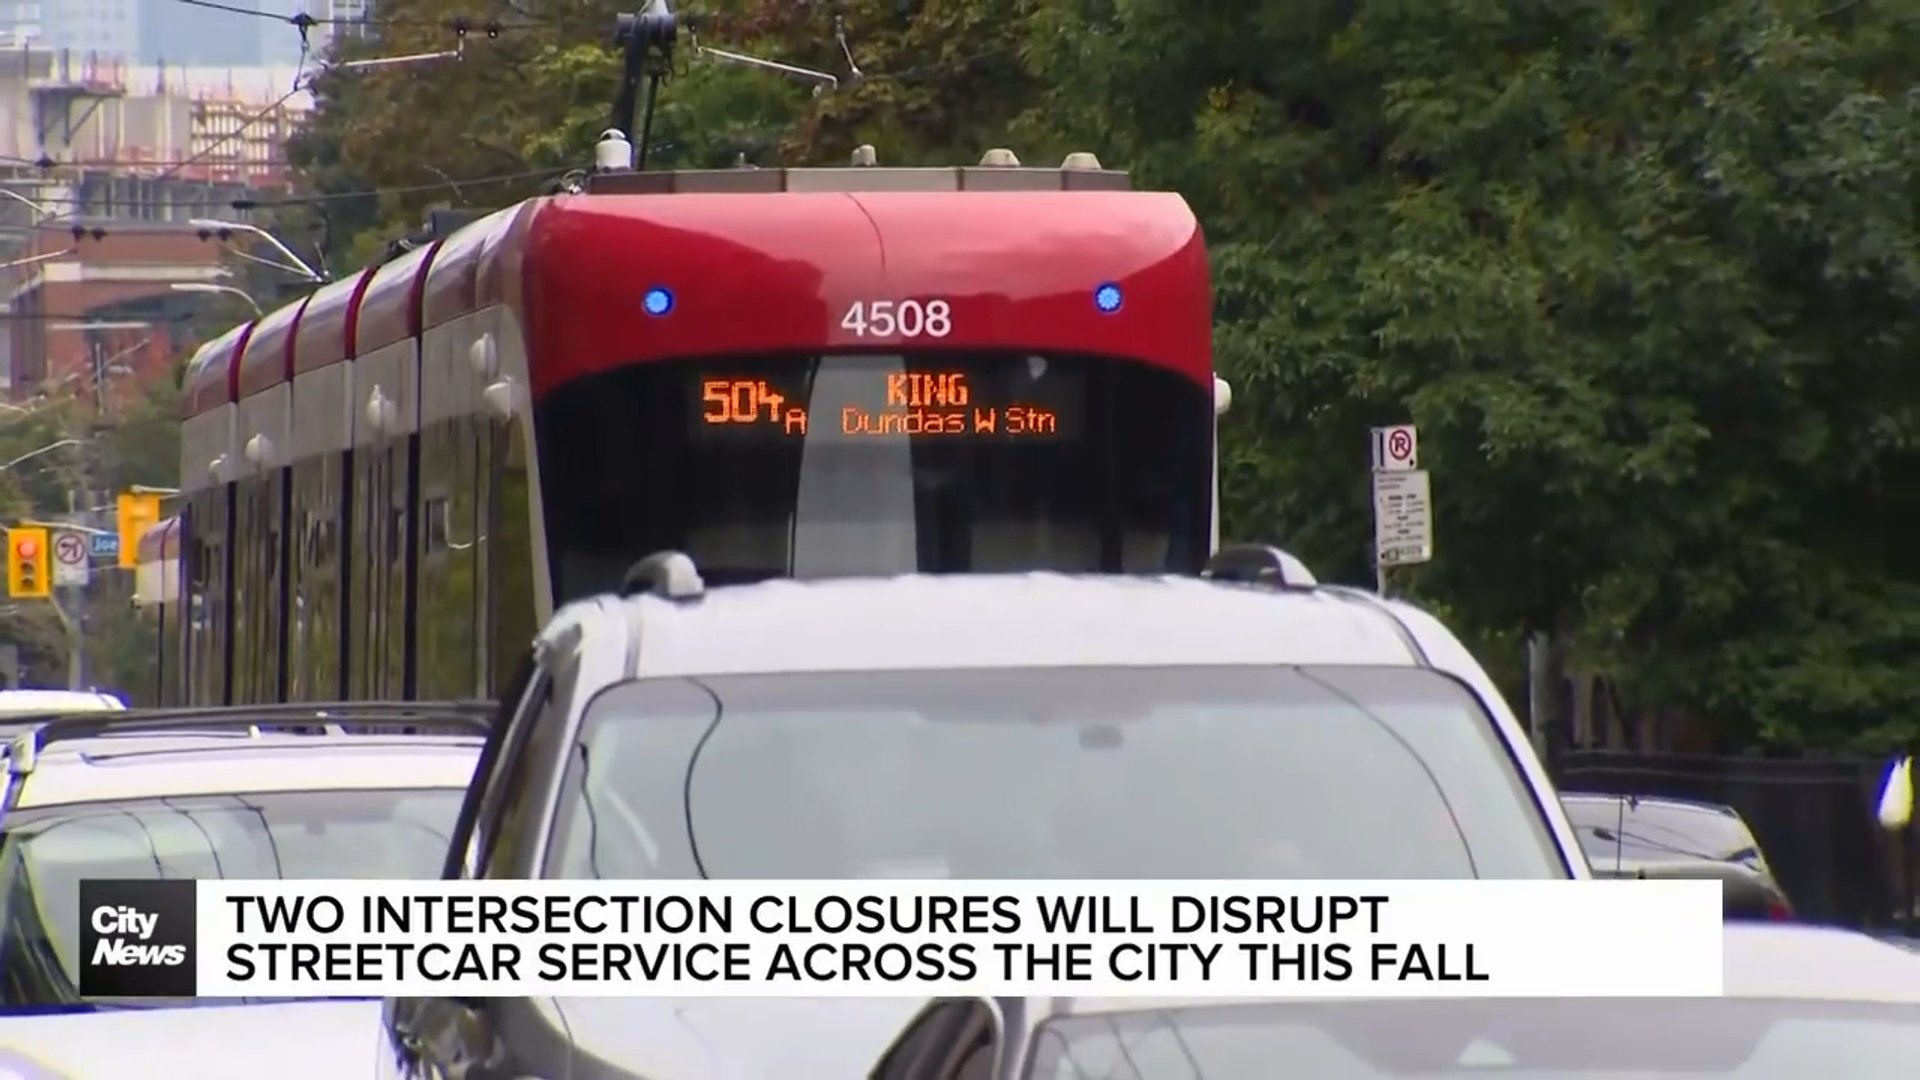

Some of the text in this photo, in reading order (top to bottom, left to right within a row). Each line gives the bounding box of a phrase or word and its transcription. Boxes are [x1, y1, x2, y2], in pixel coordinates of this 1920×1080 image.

[841, 300, 951, 337] 4508
[887, 373, 968, 406] KING
[842, 408, 1055, 434] Dundas W Stn
[94, 537, 117, 551] Joe
